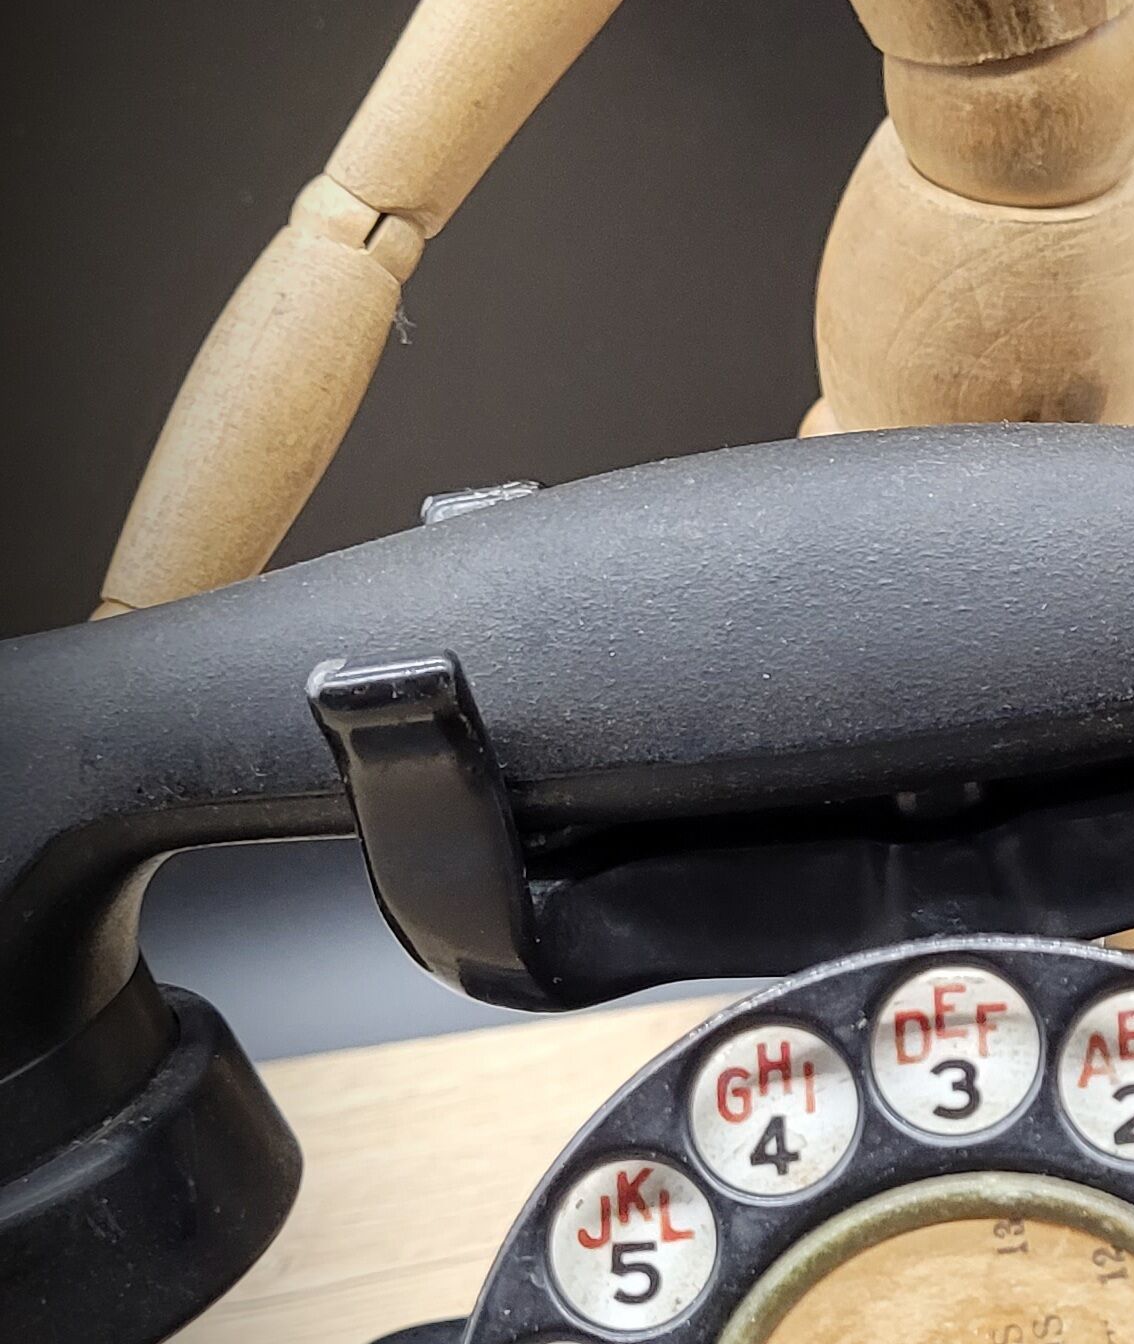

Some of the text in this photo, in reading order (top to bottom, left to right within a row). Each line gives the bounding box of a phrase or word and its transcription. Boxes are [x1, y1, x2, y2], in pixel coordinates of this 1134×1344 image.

[894, 983, 1007, 1065] DEF
[716, 1040, 816, 1124] GHI
[930, 1059, 982, 1120] 3
[750, 1115, 800, 1176] 4
[577, 1167, 695, 1249] JKL
[992, 1212, 1029, 1255] 13
[611, 1241, 663, 1304] 5
[1091, 1243, 1129, 1285] 12
